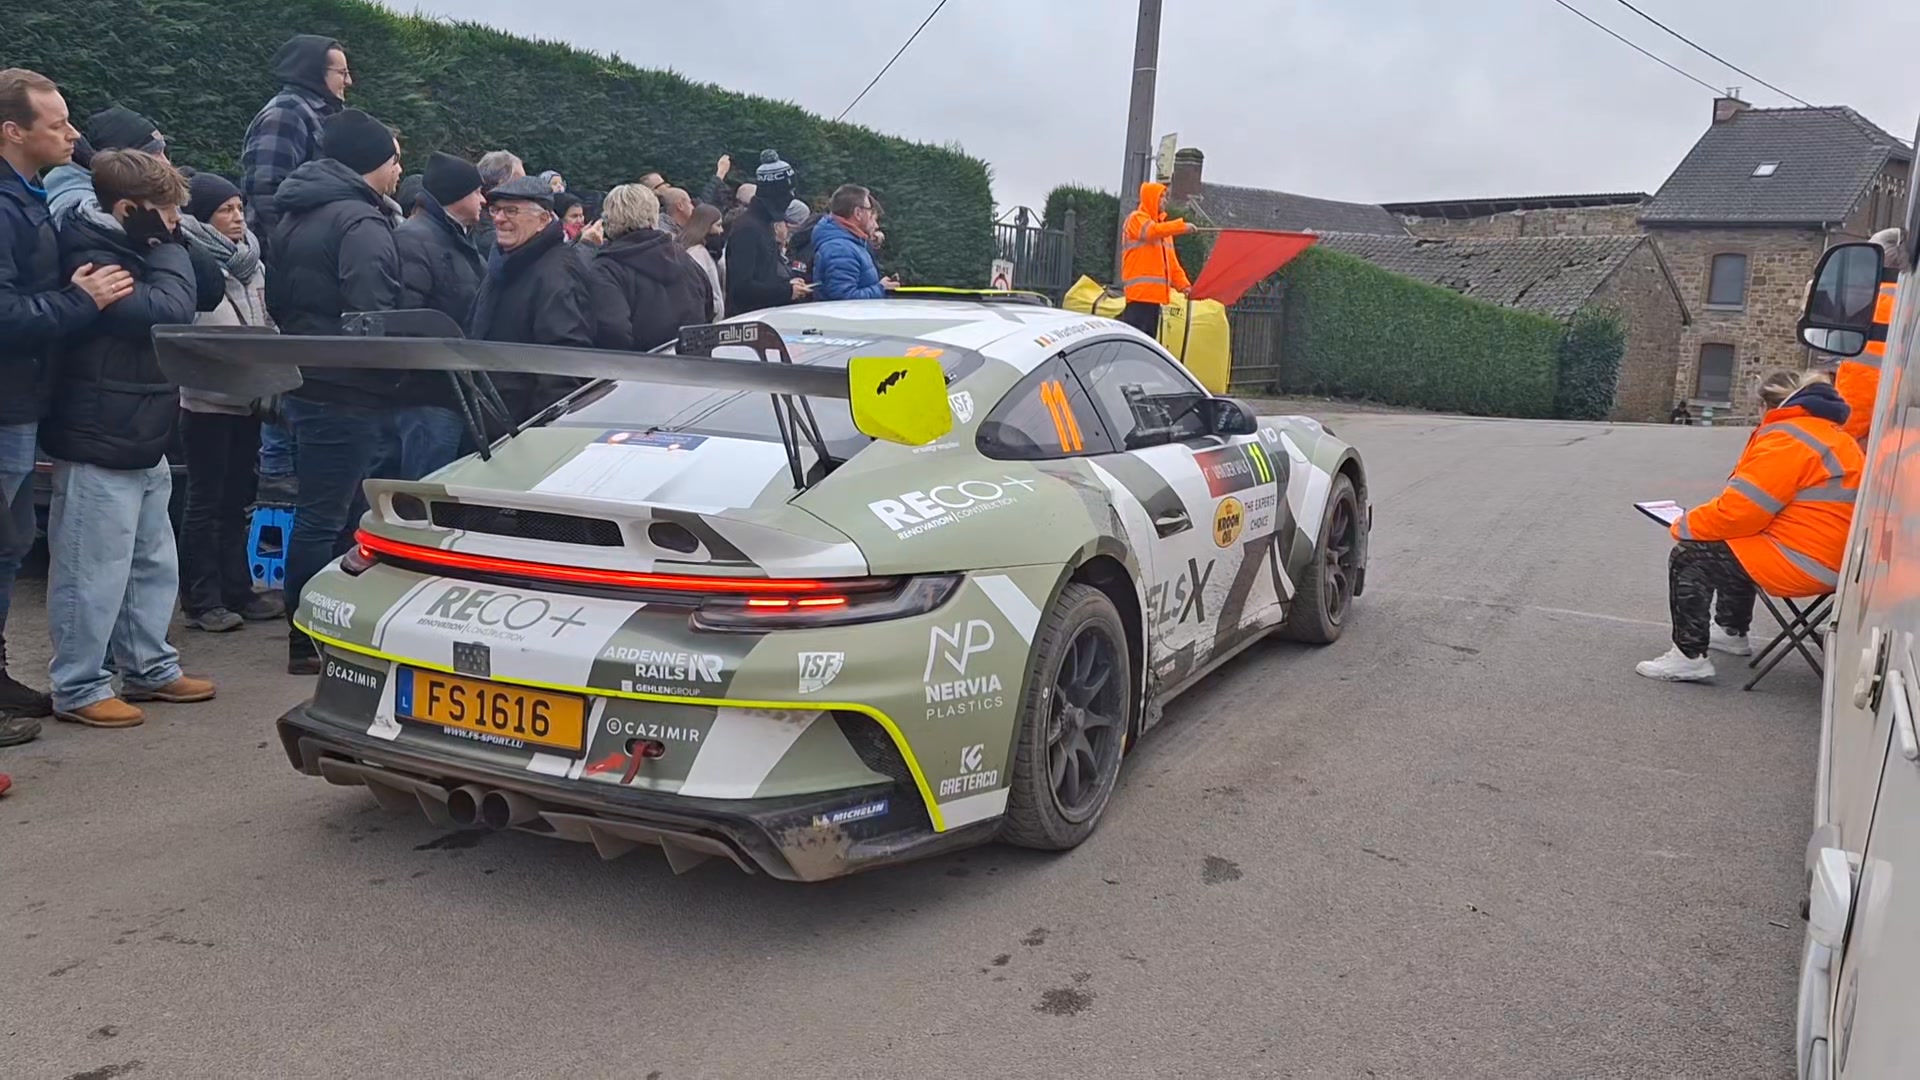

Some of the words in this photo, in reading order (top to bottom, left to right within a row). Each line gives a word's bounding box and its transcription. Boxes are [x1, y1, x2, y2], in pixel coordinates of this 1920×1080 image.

[1040, 380, 1084, 453] 11
[1247, 443, 1271, 484] 11
[1217, 513, 1240, 532] KROON
[1222, 530, 1233, 545] OIL
[603, 646, 688, 666] ARDENNE
[800, 654, 836, 679] ISF
[335, 666, 377, 689] CAZIMIR
[635, 663, 685, 680] RAILS
[635, 682, 701, 697] GEHLENGROUP
[925, 674, 1002, 703] NERVIA
[402, 696, 408, 708] L
[926, 696, 1003, 720] PLASTICS
[625, 721, 700, 742] CAZIMIR
[939, 770, 998, 797] GRETERCO
[832, 803, 885, 822] MICHELIN
